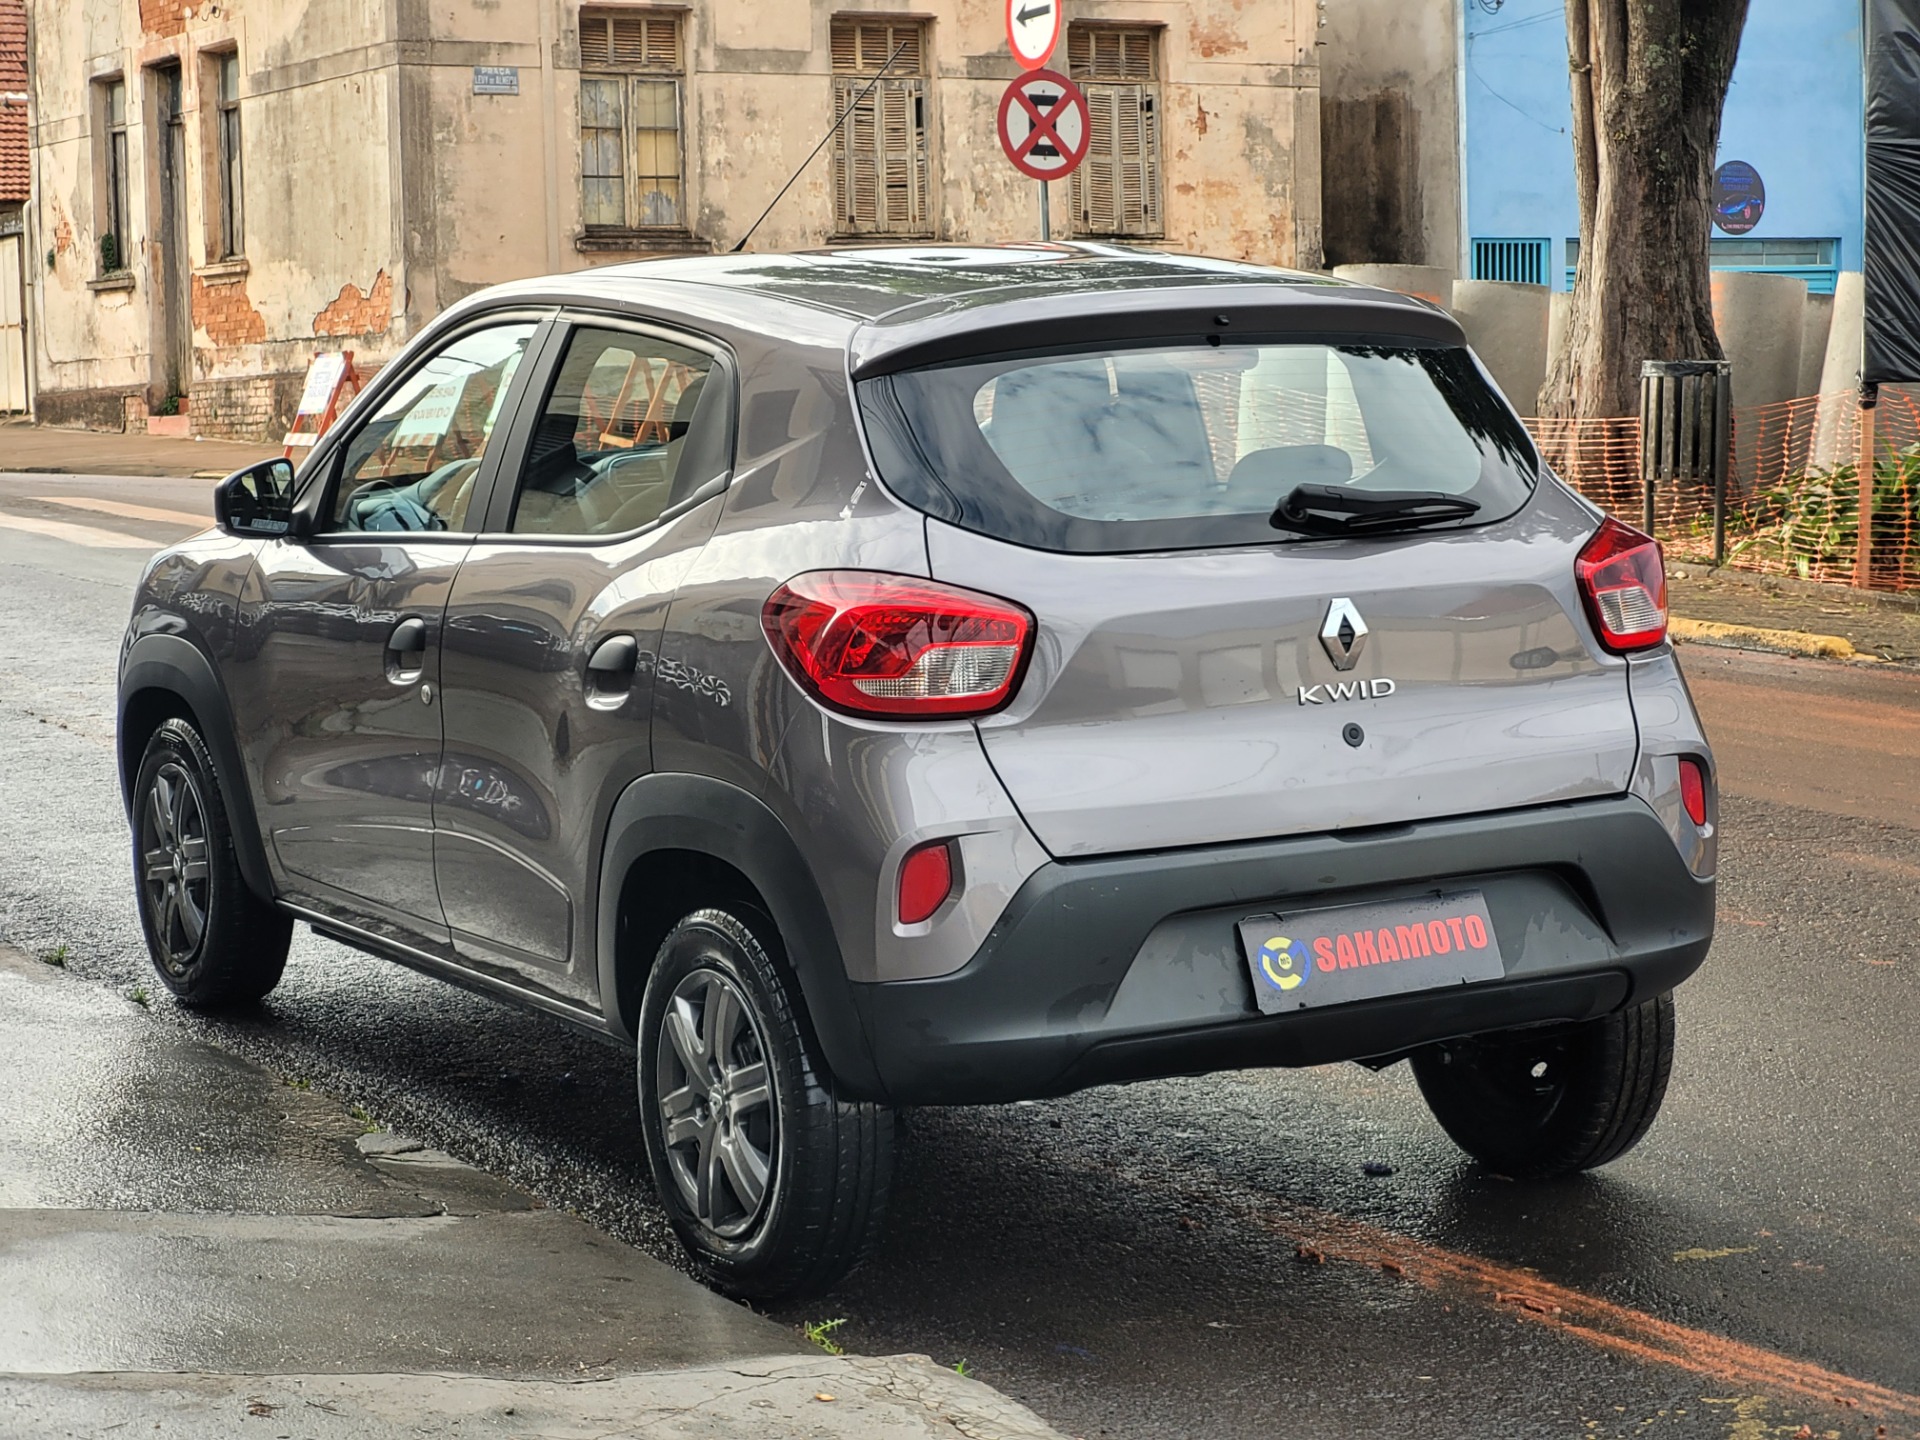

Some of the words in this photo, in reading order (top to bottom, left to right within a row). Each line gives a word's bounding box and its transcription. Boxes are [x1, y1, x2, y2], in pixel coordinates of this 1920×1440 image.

[481, 67, 511, 75] PRAÇA
[1298, 677, 1396, 705] KWID
[1313, 914, 1488, 973] SAKAMOTO
